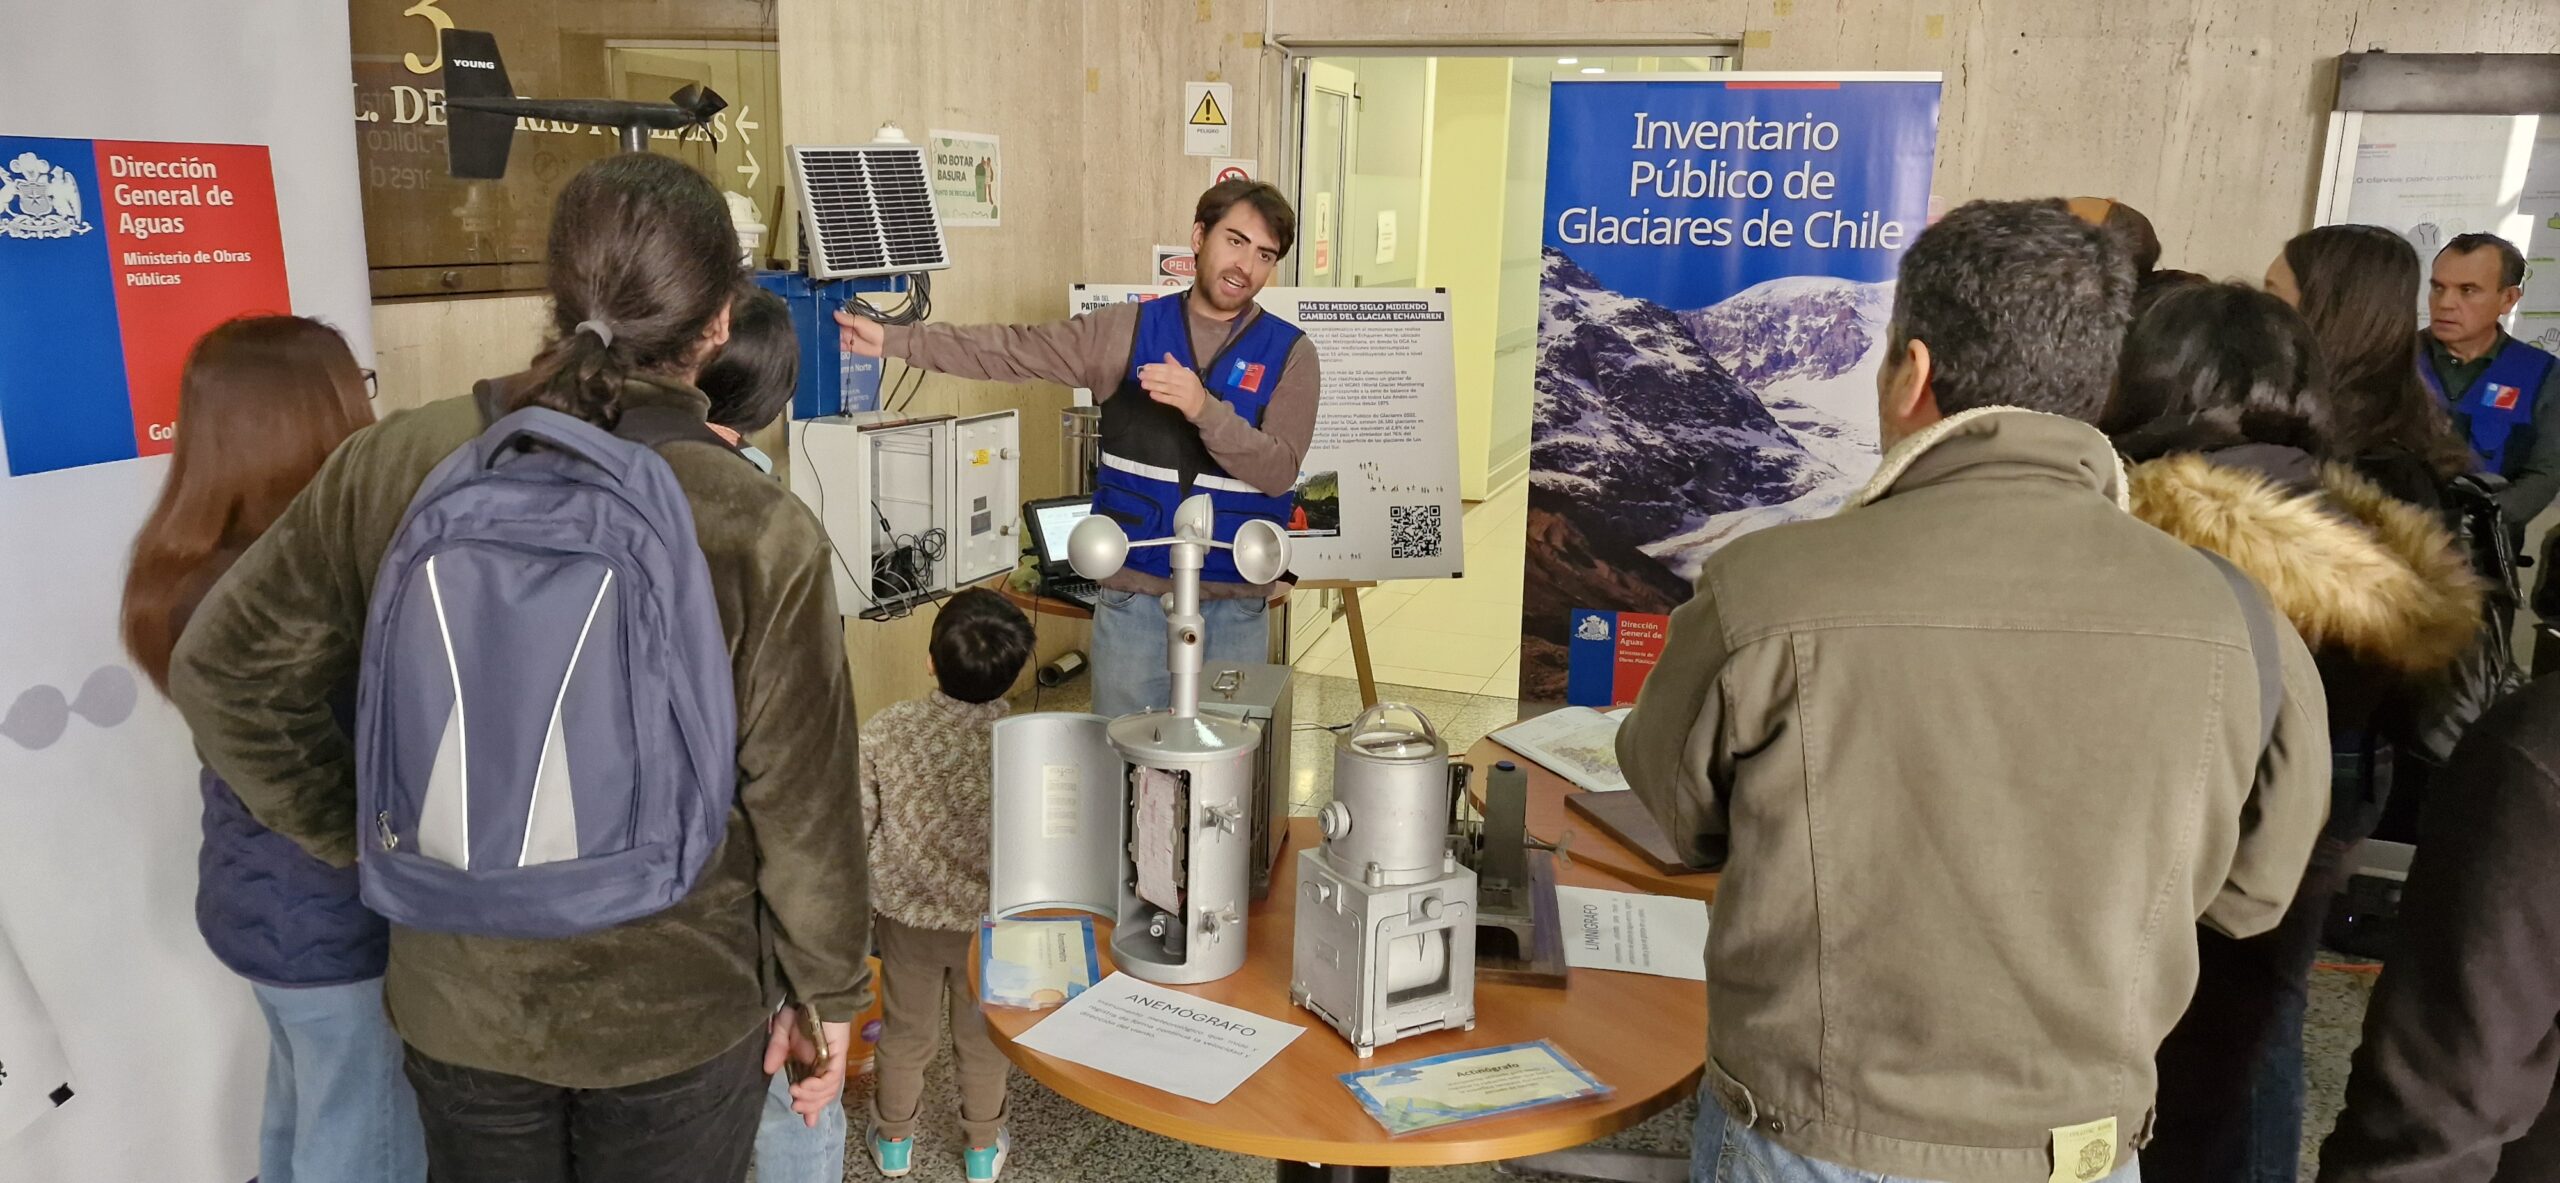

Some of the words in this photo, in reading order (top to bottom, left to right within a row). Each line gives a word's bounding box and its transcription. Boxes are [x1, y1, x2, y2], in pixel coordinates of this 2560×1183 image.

[453, 59, 495, 70] YOUNG
[390, 85, 448, 126] DE
[1632, 112, 1839, 151] Inventario
[110, 155, 217, 179] Dirección
[937, 153, 948, 165] NO
[949, 154, 974, 167] BOTAR
[937, 169, 967, 182] BASURA
[1630, 159, 1772, 199] Público
[1783, 161, 1835, 200] de
[114, 184, 201, 207] General
[206, 185, 234, 206] de
[119, 213, 185, 240] Aguas
[1558, 207, 1731, 247] Glaciares
[1743, 208, 1792, 248] de
[1804, 210, 1904, 250] Chile
[124, 251, 191, 266] Ministerio
[194, 251, 210, 264] de
[213, 250, 251, 263] Obras
[126, 272, 181, 287] Públicas
[1300, 302, 1317, 310] MÁS
[1319, 303, 1330, 311] DE
[1331, 303, 1358, 311] MEDIO
[1360, 303, 1385, 311] SIGLO
[1386, 303, 1428, 311] MIDIENDO
[1621, 620, 1658, 630] Dirección
[1621, 629, 1651, 638] General
[1652, 630, 1662, 639] de
[1620, 638, 1644, 647] Aguas
[1124, 994, 1257, 1037] ANEMÓGRAFO
[1457, 1062, 1519, 1077] Actinógrafo
